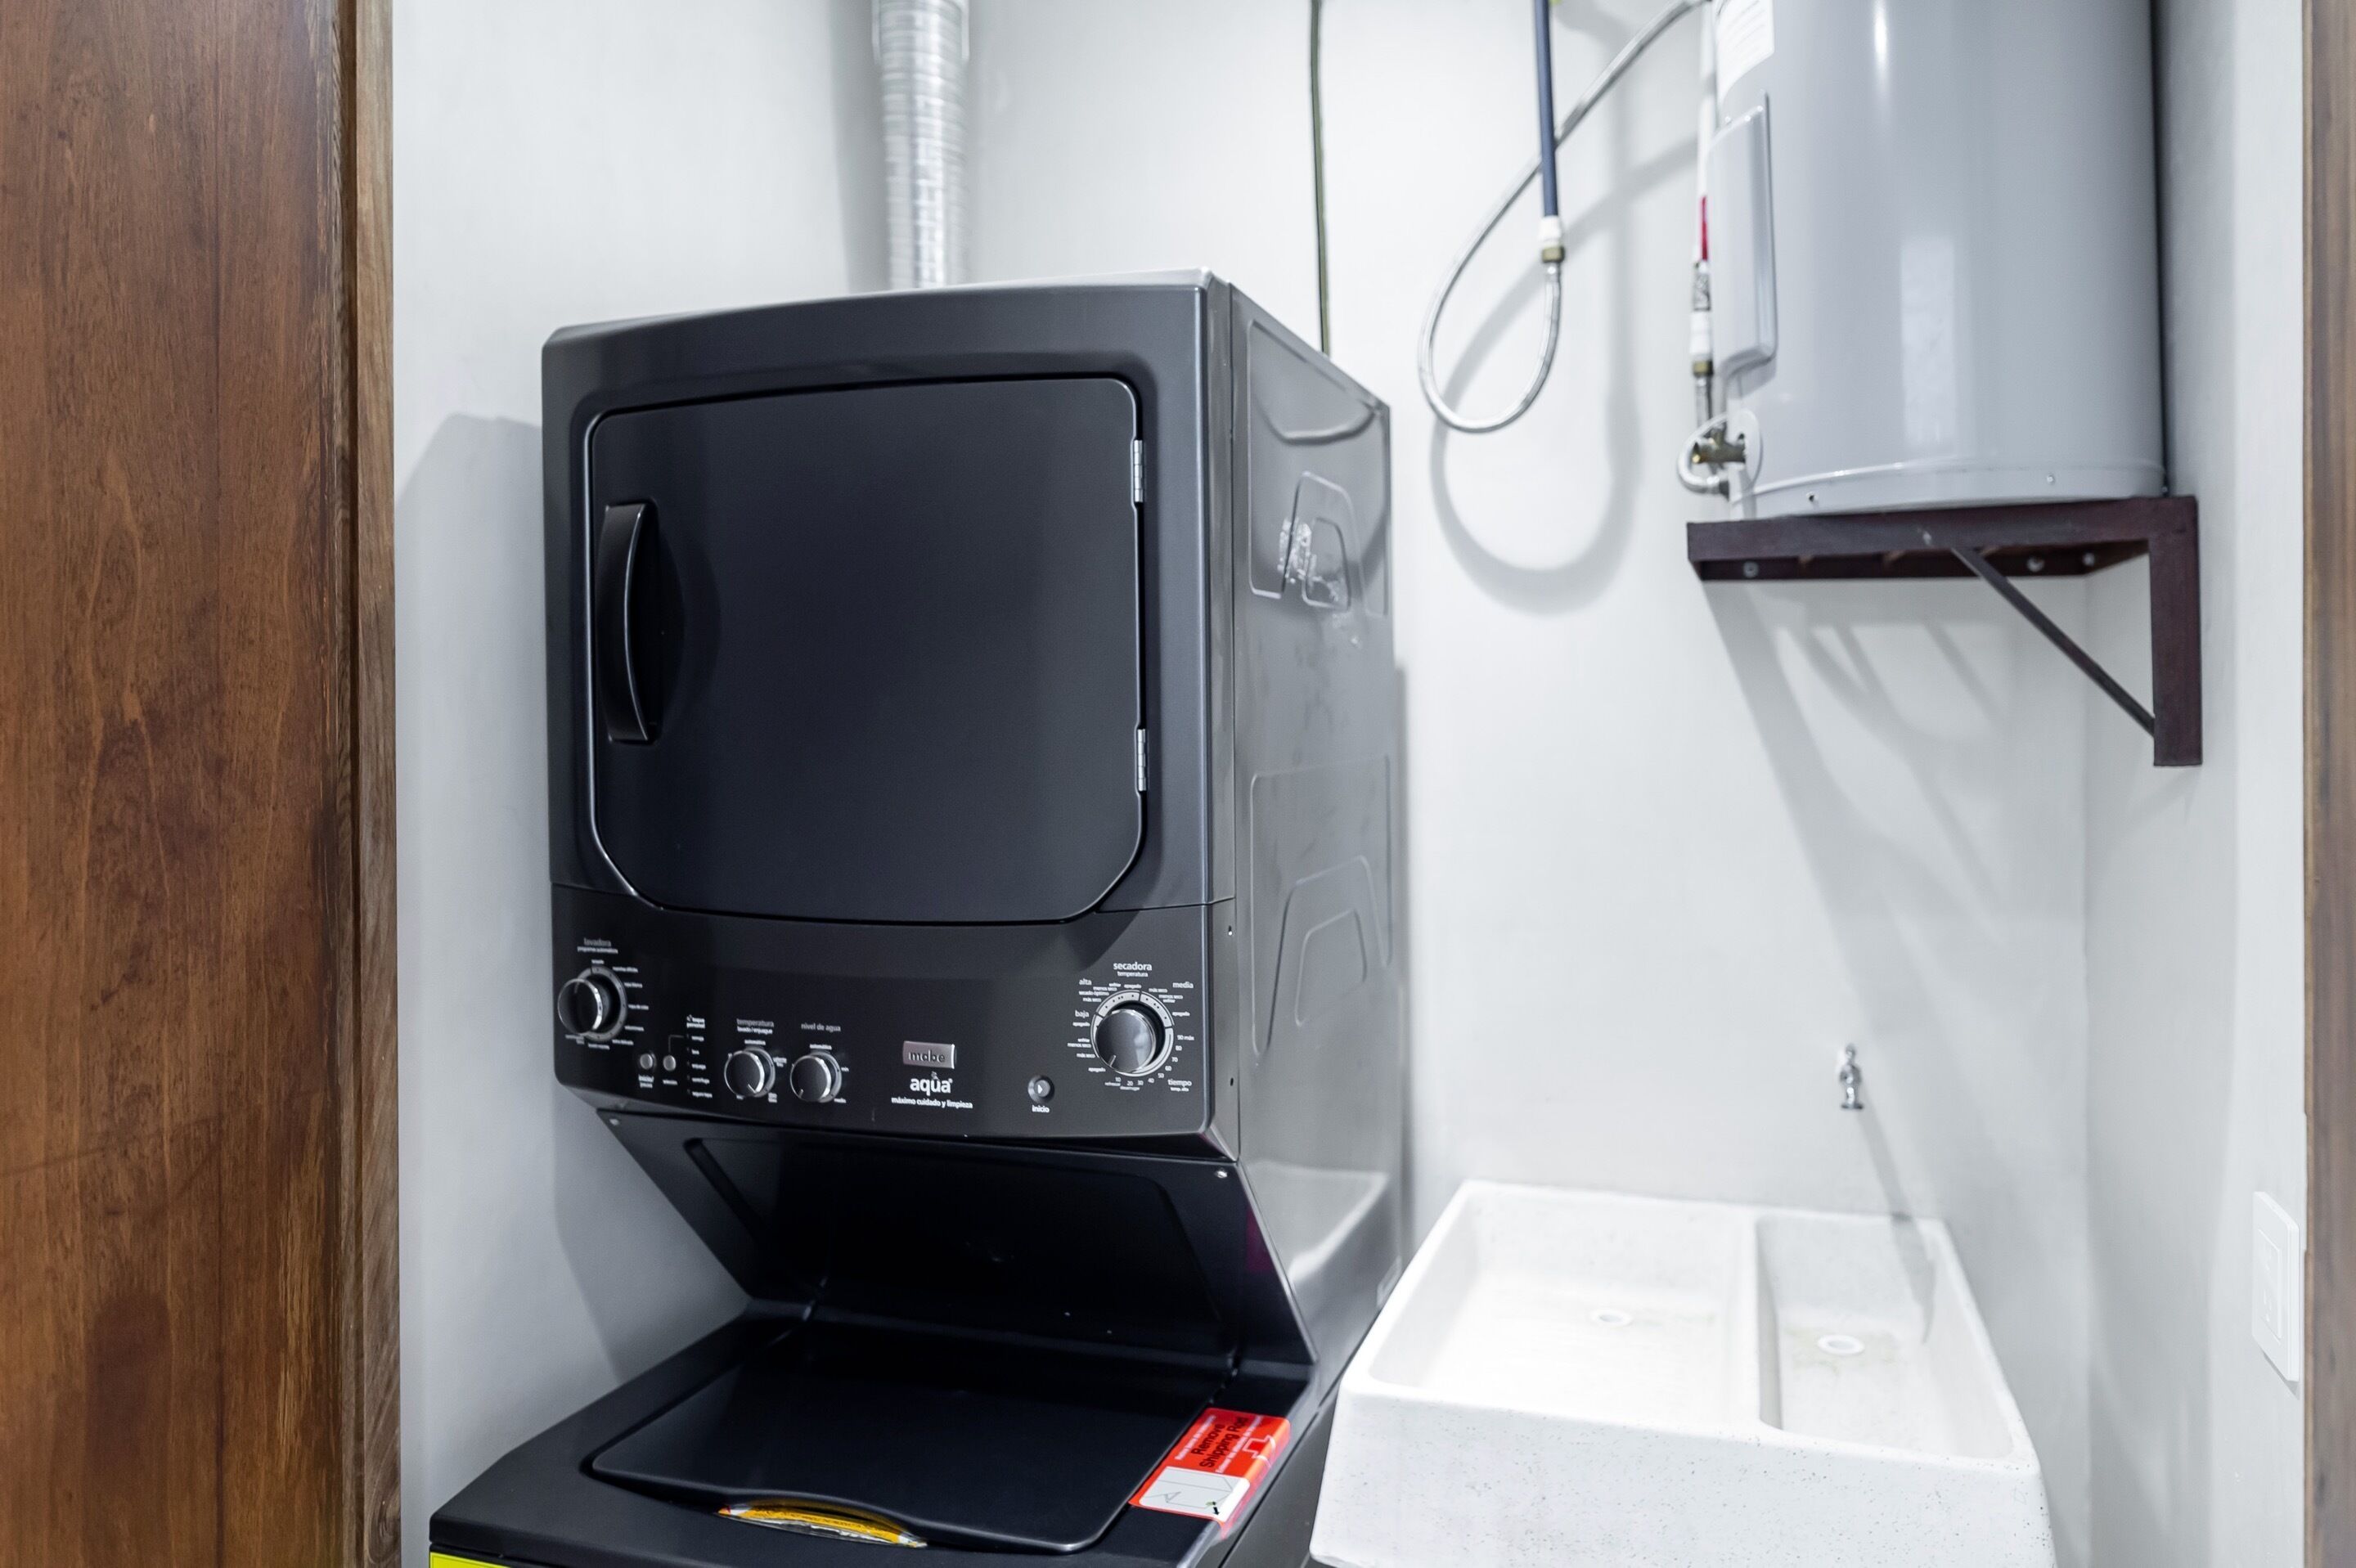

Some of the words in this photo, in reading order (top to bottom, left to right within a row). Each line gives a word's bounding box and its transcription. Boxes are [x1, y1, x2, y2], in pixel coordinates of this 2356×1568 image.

[1113, 962, 1152, 972] secadora
[1075, 1010, 1089, 1018] baja
[909, 1049, 945, 1063] mabe
[1167, 1079, 1192, 1087] tiempo
[946, 1099, 973, 1108] limpieza
[1191, 1424, 1225, 1455] Remove
[1200, 1431, 1241, 1468] Shipping
